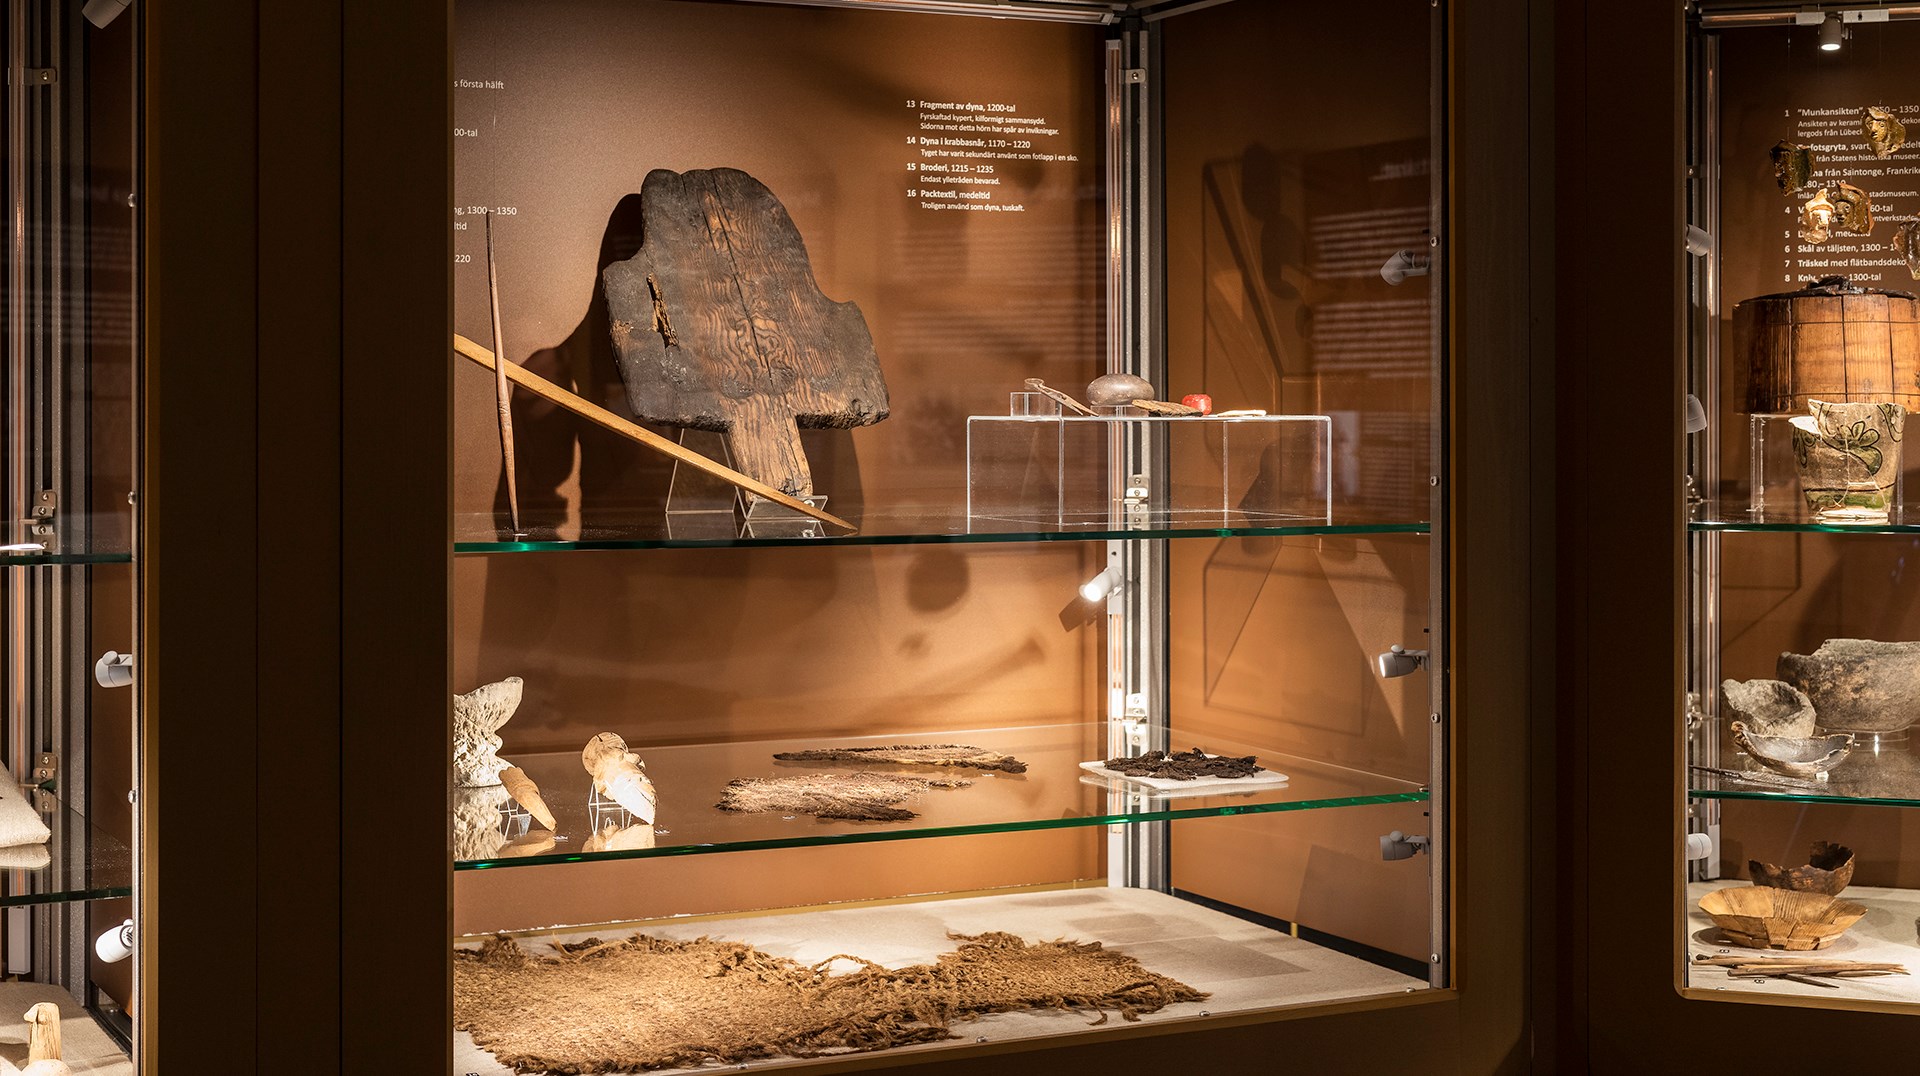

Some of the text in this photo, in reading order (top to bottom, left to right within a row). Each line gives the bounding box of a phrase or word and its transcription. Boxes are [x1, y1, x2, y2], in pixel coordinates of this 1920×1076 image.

[460, 79, 484, 89] första
[485, 80, 504, 89] hälft
[906, 100, 916, 108] 13
[920, 100, 954, 110] Fragment
[965, 102, 986, 112] dyna,
[987, 103, 1016, 112] 1200-tal
[1785, 109, 1790, 117] 1
[1899, 104, 1919, 113] 1350
[920, 112, 951, 121] Fyrskaftad
[953, 114, 974, 122] kypert,
[975, 115, 1004, 124] kilformigt
[1798, 120, 1828, 128] Ansikten
[1003, 126, 1016, 134] spår
[1026, 127, 1059, 136] invikningar.
[1797, 130, 1823, 138] lergods
[906, 136, 916, 144] 14
[920, 137, 939, 146] Dyna
[944, 138, 987, 148] krabbasnår,
[988, 140, 1005, 148] 1170
[1013, 140, 1031, 149] 1220
[921, 149, 937, 157] Tyget
[1032, 153, 1054, 162] fotlapp
[1831, 154, 1857, 162] Statens
[906, 163, 916, 171] 15
[920, 163, 950, 173] Broderi,
[1825, 168, 1841, 176] från
[1842, 168, 1885, 177] Saintonge,
[920, 175, 1000, 185] Endast ylletråden bevarad.
[920, 190, 958, 199] Packtextil,
[467, 206, 487, 214] 1300
[497, 207, 517, 216] 1350
[921, 202, 946, 210] Troligen
[984, 204, 1001, 212] dyna,
[1002, 204, 1025, 212] tuskaft.
[1785, 230, 1790, 239] 5
[1785, 245, 1790, 253] 6
[1797, 244, 1815, 253] Skål
[1827, 244, 1859, 254] täljsten,
[1861, 243, 1881, 252] 1300
[1797, 259, 1829, 267] Träsked
[1830, 259, 1849, 267] med
[1785, 274, 1790, 282] 8
[1849, 272, 1882, 281] 1300-tal
